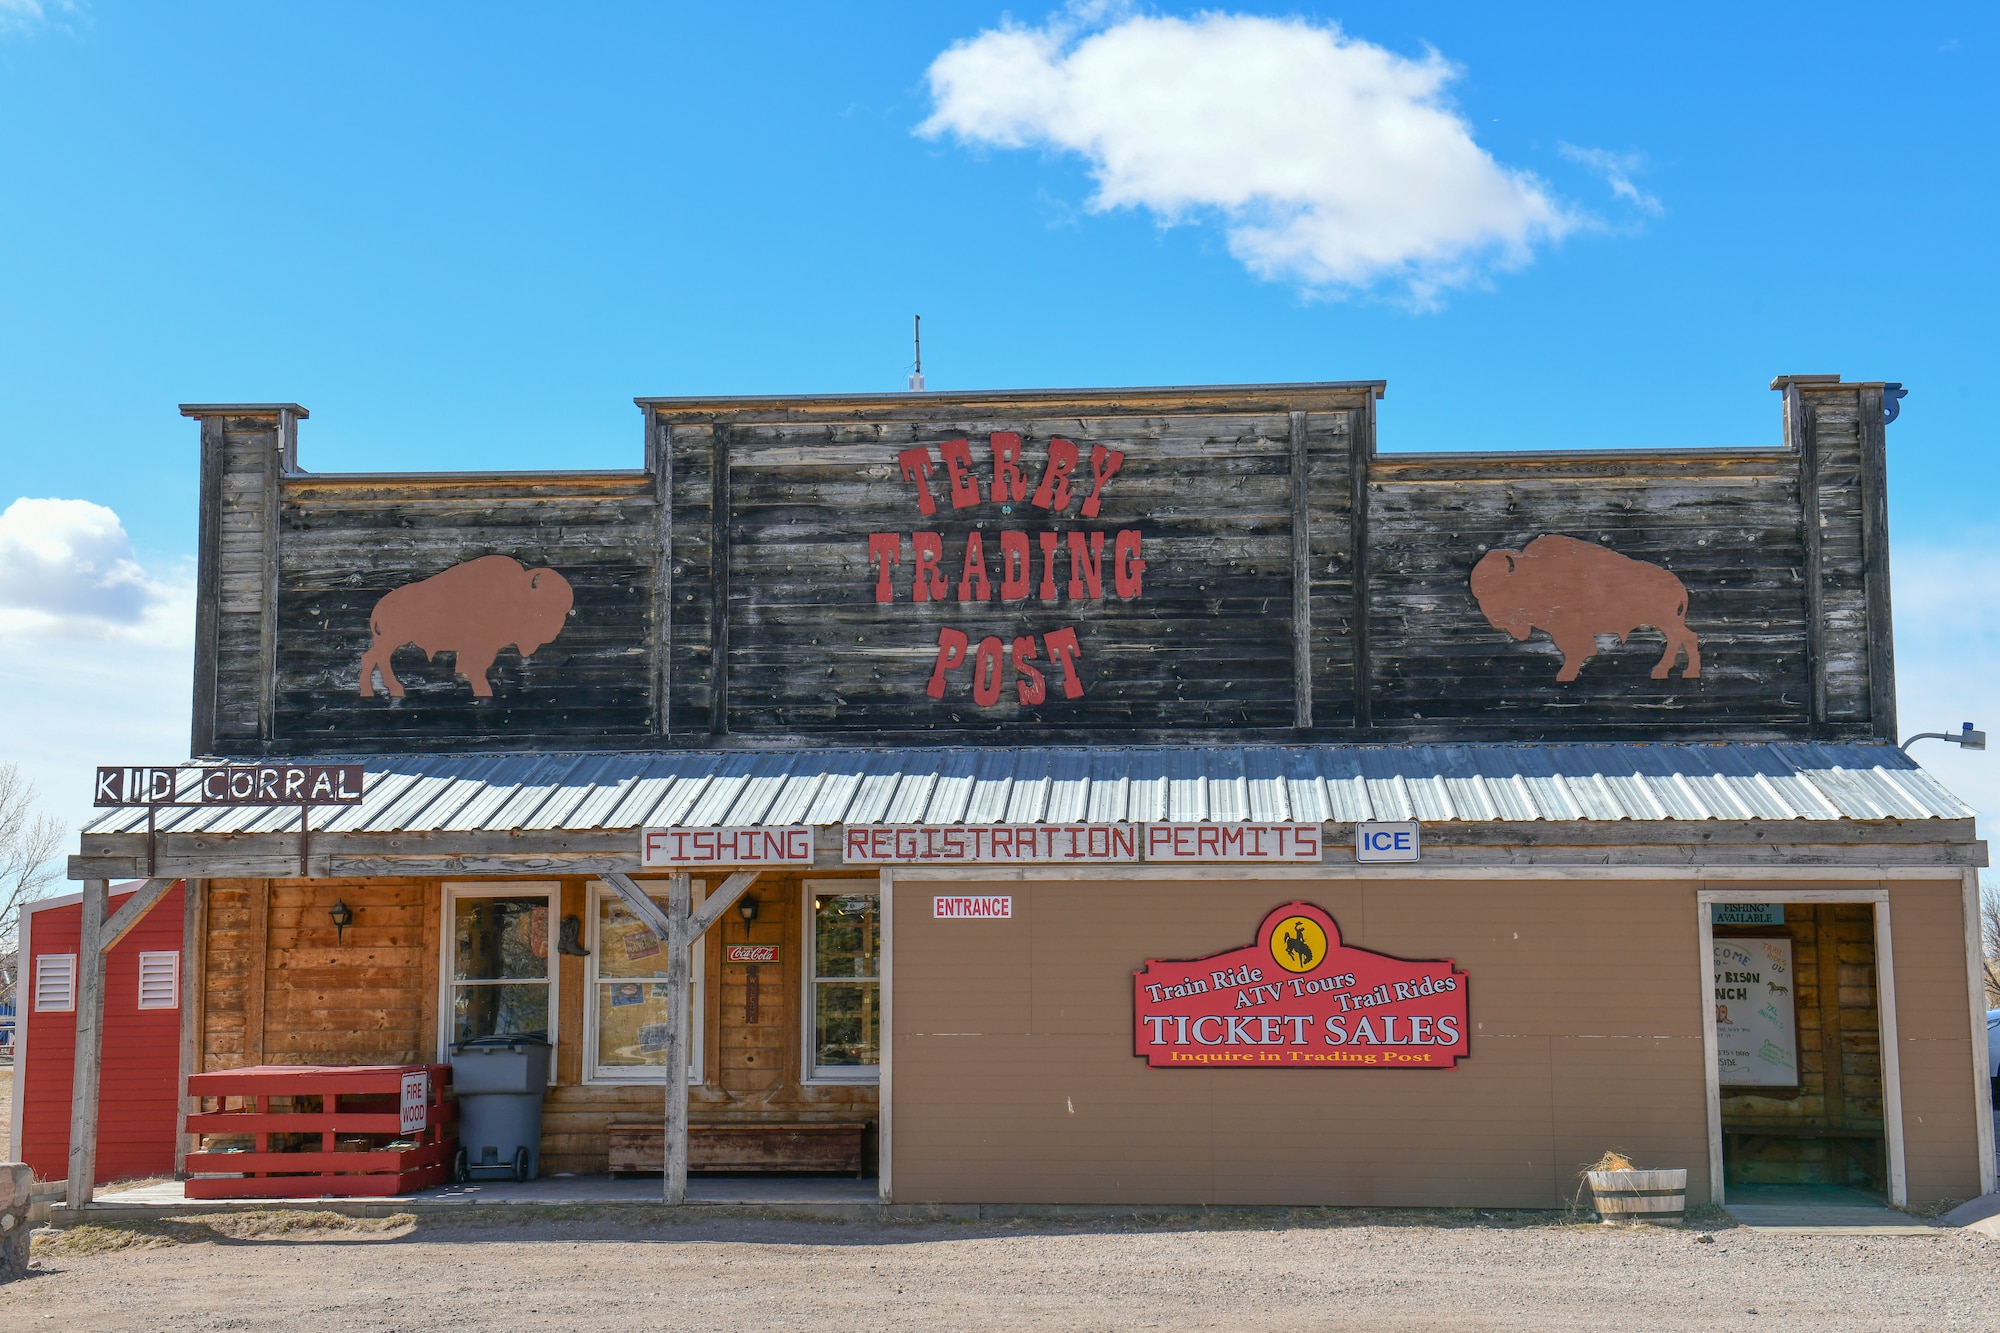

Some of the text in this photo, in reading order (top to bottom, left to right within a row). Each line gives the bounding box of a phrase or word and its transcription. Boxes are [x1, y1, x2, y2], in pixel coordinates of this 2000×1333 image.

[898, 432, 1124, 517] TERRY
[868, 529, 1146, 603] TRADING
[926, 626, 1085, 707] POST
[96, 769, 360, 800] KID CORRAL
[646, 826, 1317, 861] FISHING REGISTRATION PERMITS
[1364, 831, 1411, 851] ICE
[936, 898, 1009, 916] ENTRANCE
[1724, 904, 1765, 913] FISHING
[1717, 913, 1772, 923] AVAILABLE
[730, 946, 774, 961] Coca-Cola
[1714, 947, 1751, 967] COME
[1145, 964, 1263, 1003] Train Ride
[1725, 971, 1760, 983] BISON
[1234, 973, 1356, 1010] ATV Tours
[1334, 975, 1457, 1013] Trail Rides
[1715, 988, 1747, 1001] NCH
[1143, 1015, 1460, 1046] TICKET SALES
[1171, 1051, 1432, 1064] Inquire in Trading Post
[1718, 1058, 1737, 1066] SIDE
[407, 1082, 422, 1100] FIRE
[402, 1104, 424, 1123] WOOD
